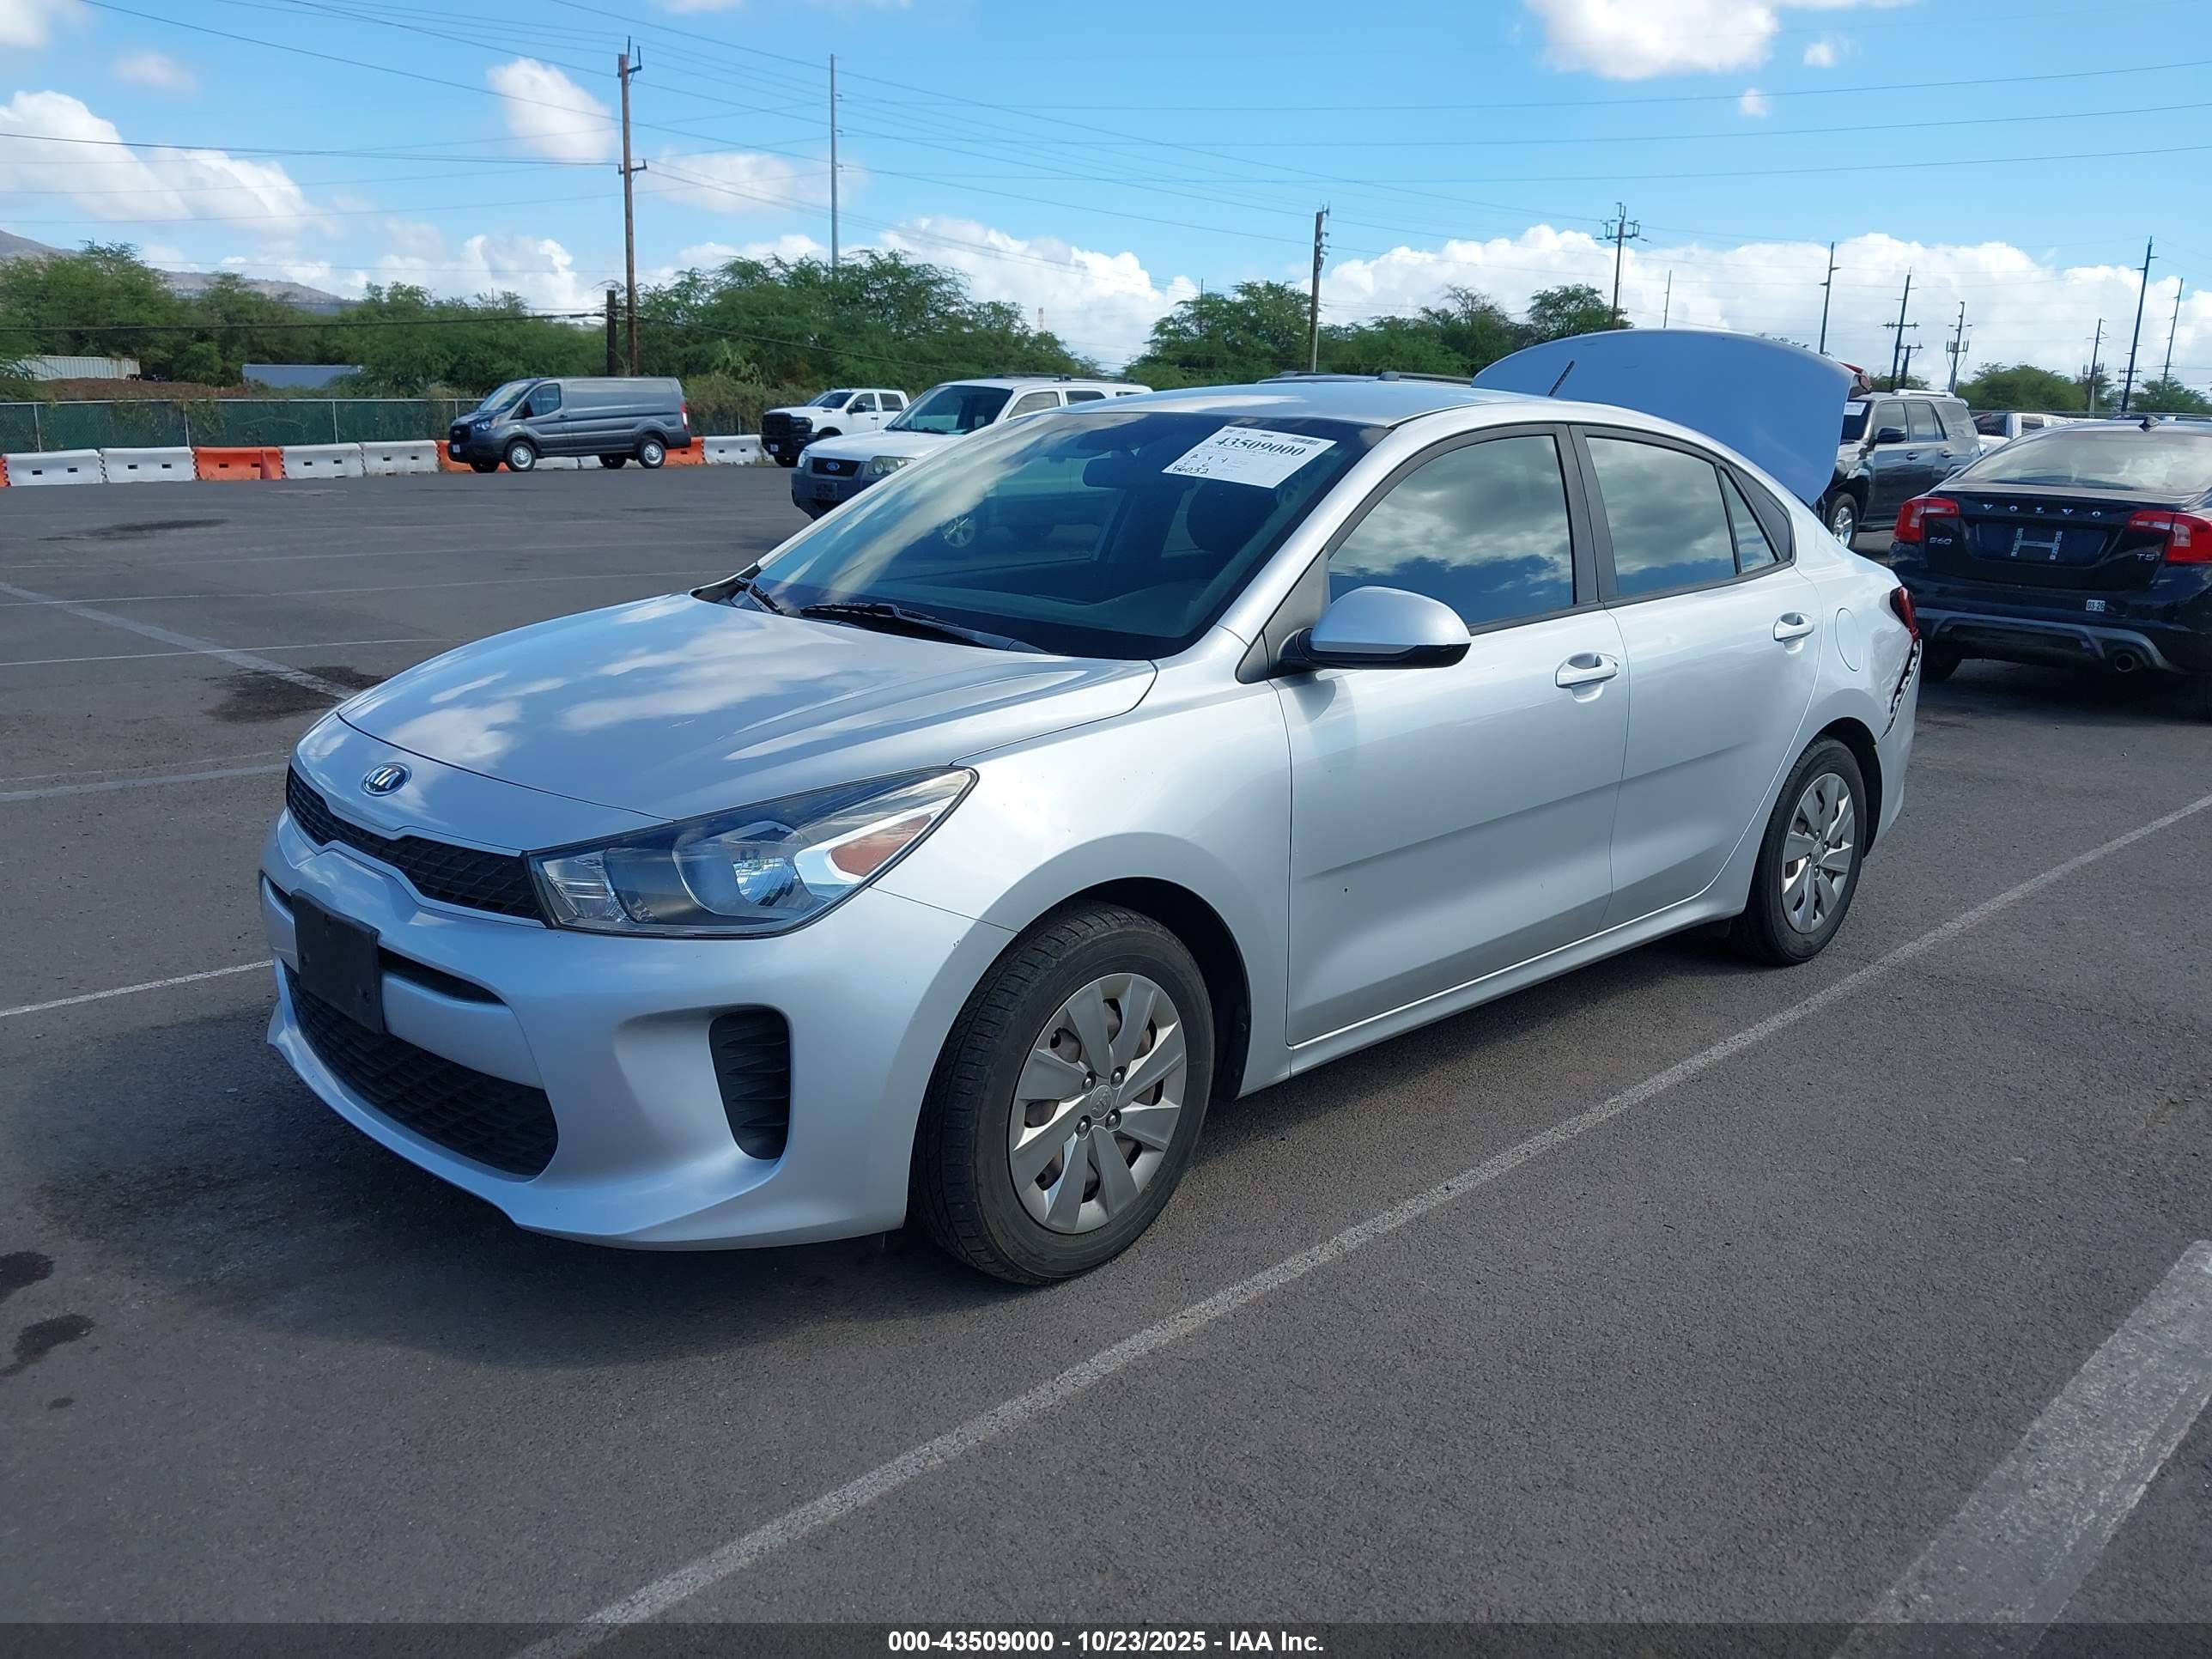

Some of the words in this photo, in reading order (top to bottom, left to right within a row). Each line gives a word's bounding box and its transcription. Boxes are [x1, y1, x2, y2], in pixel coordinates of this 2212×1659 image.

[1216, 437, 1306, 459] 43509000
[1983, 504, 2102, 518] VOLVO
[1929, 537, 1952, 545] S60
[2136, 553, 2155, 562] T5
